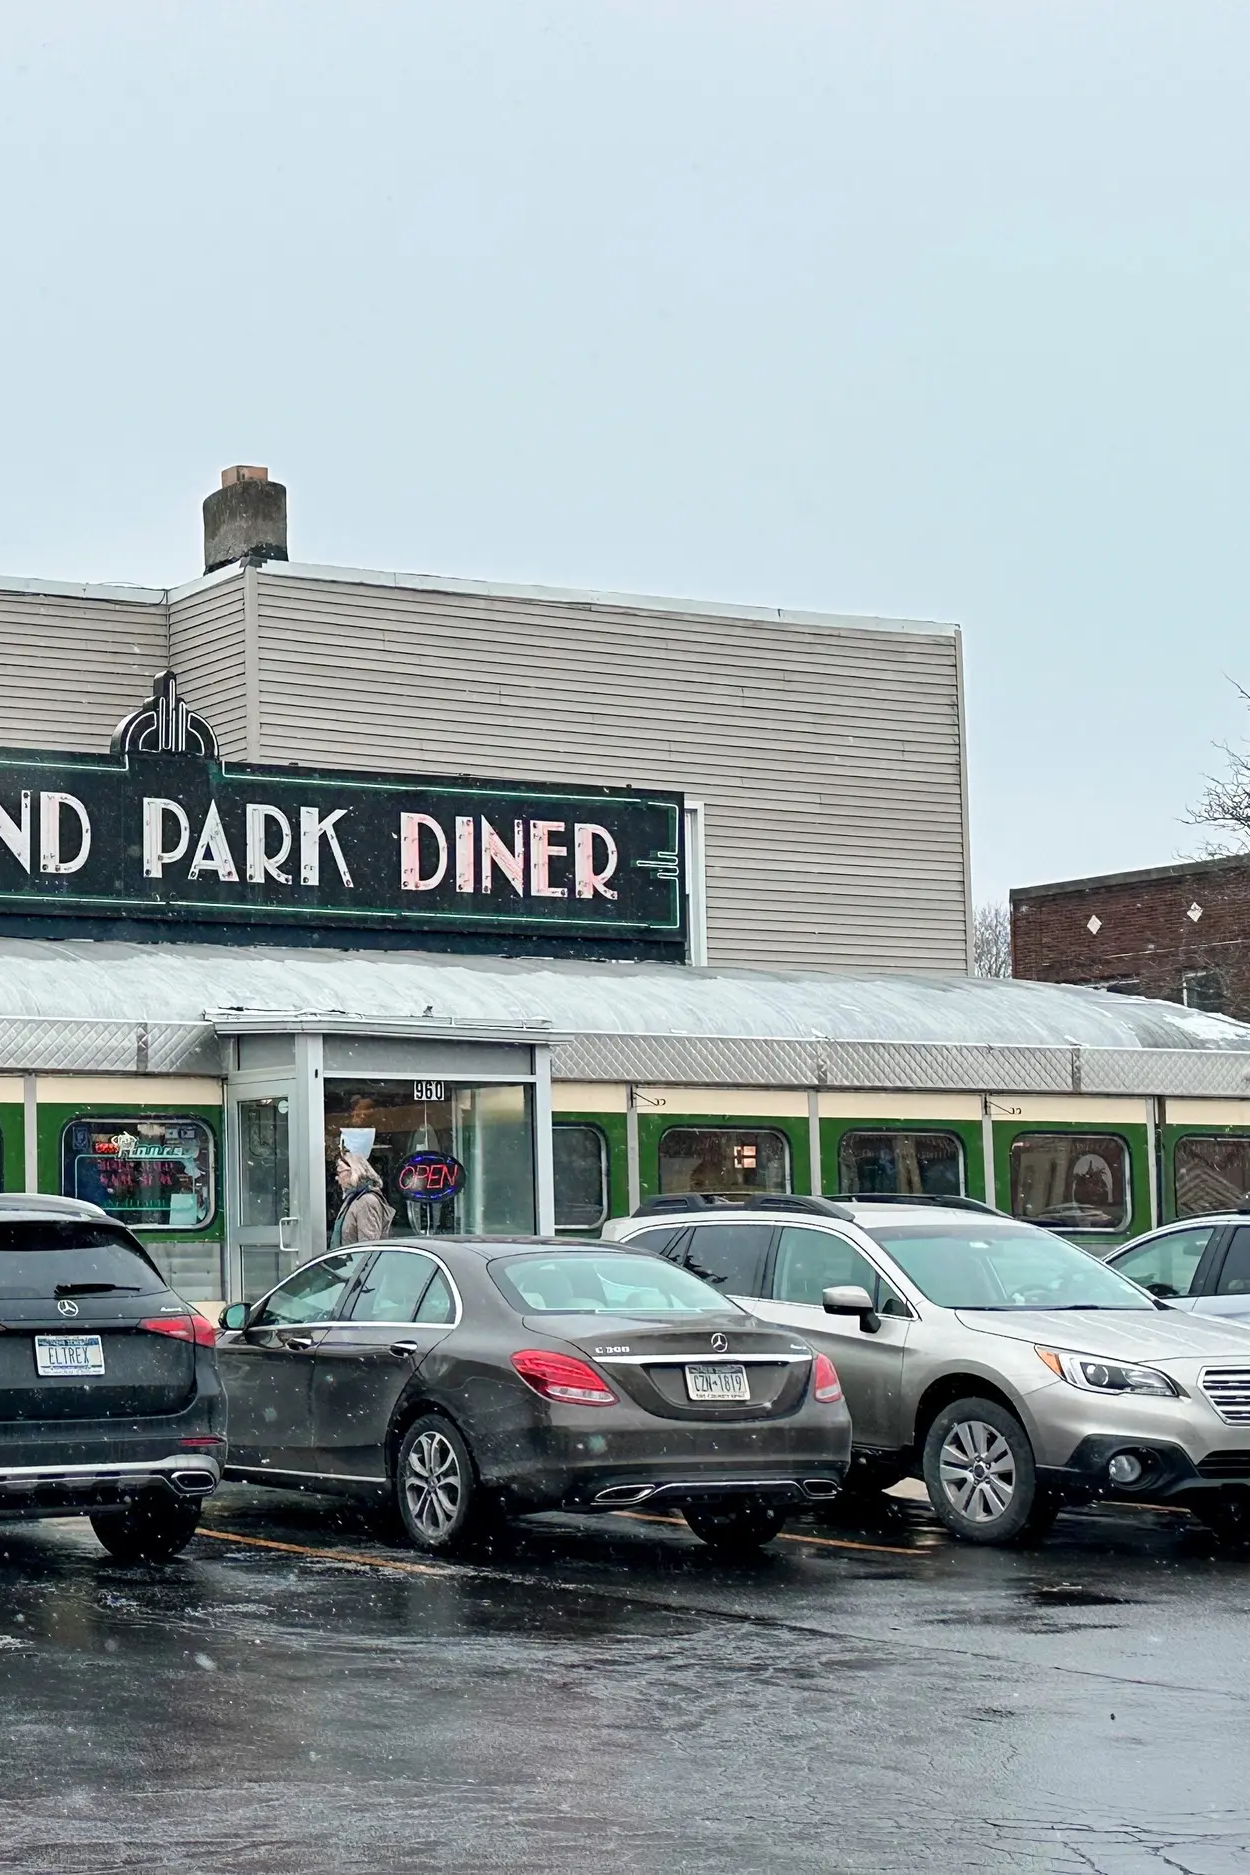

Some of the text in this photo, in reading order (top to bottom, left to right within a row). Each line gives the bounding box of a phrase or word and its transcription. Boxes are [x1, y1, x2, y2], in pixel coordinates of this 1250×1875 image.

[143, 797, 354, 887] PARK
[400, 811, 618, 899] DINER
[414, 1081, 444, 1100] 960
[398, 1164, 459, 1190] OPEN
[48, 1347, 90, 1365] ELTREX
